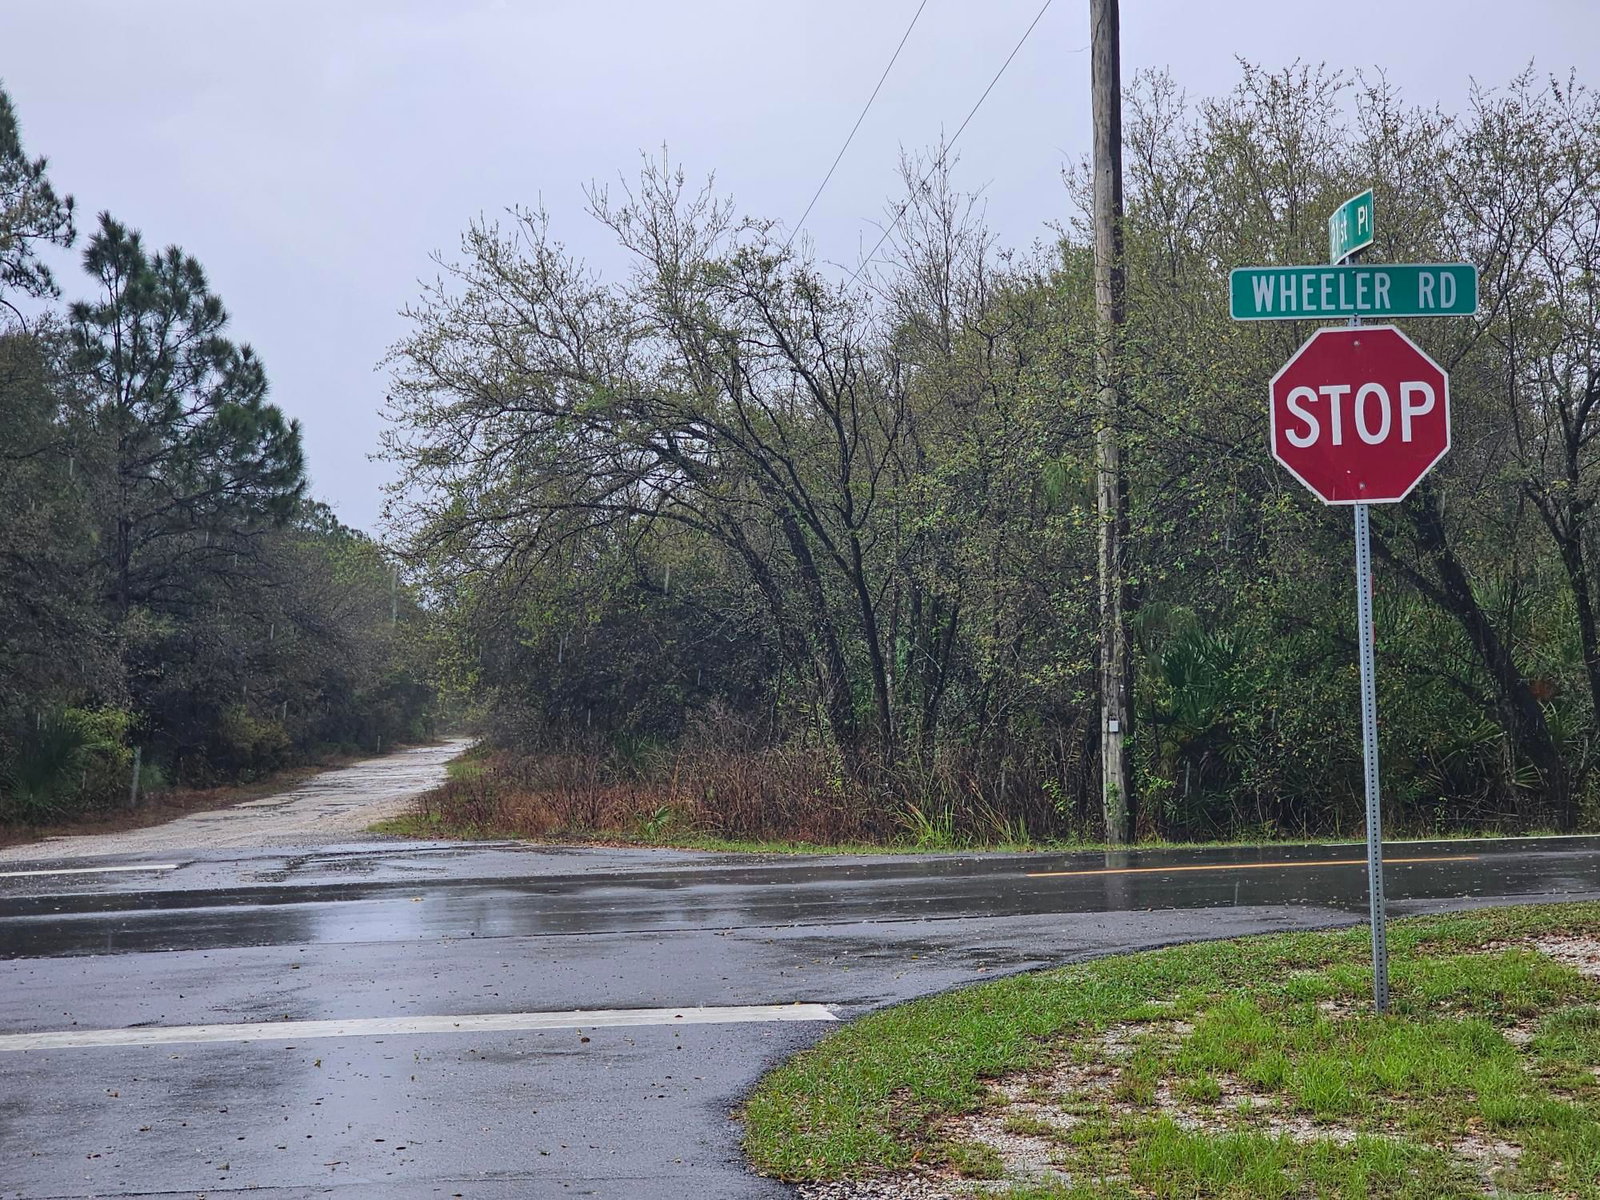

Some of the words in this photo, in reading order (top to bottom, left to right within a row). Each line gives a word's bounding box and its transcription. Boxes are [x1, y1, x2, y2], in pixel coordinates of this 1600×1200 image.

[1252, 272, 1391, 312] WHEELER
[1419, 271, 1457, 309] RD
[1284, 381, 1436, 449] STOP
